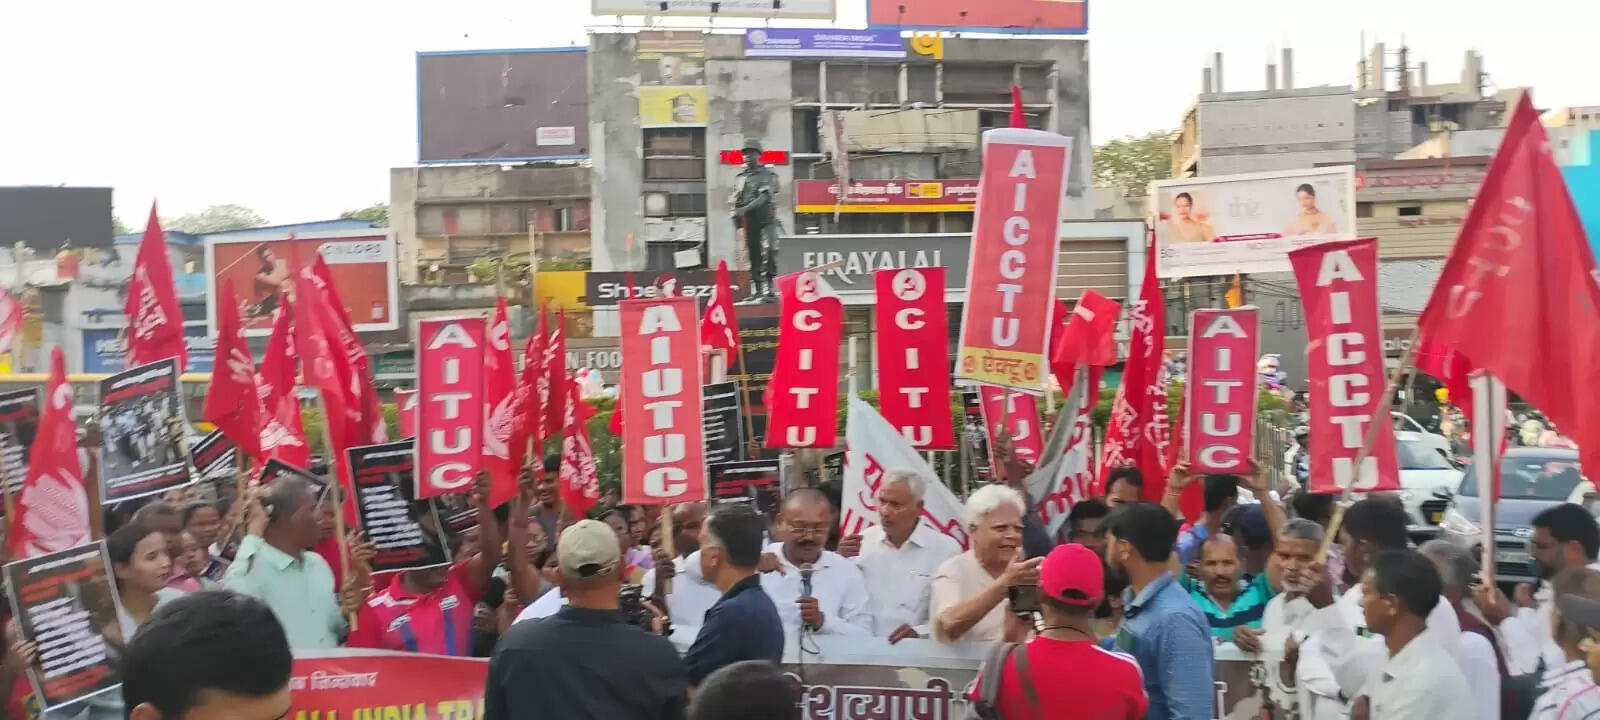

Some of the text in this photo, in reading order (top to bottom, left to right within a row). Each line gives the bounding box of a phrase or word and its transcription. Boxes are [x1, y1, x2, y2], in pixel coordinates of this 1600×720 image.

[991, 149, 1037, 347] AICCTU
[427, 322, 478, 489] AITUC
[638, 304, 689, 498] AIUTUC
[786, 308, 823, 447] CITU
[895, 307, 933, 446] CITU
[1200, 314, 1249, 469] AITUC
[1315, 249, 1380, 489] AICCTU
[784, 672, 951, 720] शव्यापी
